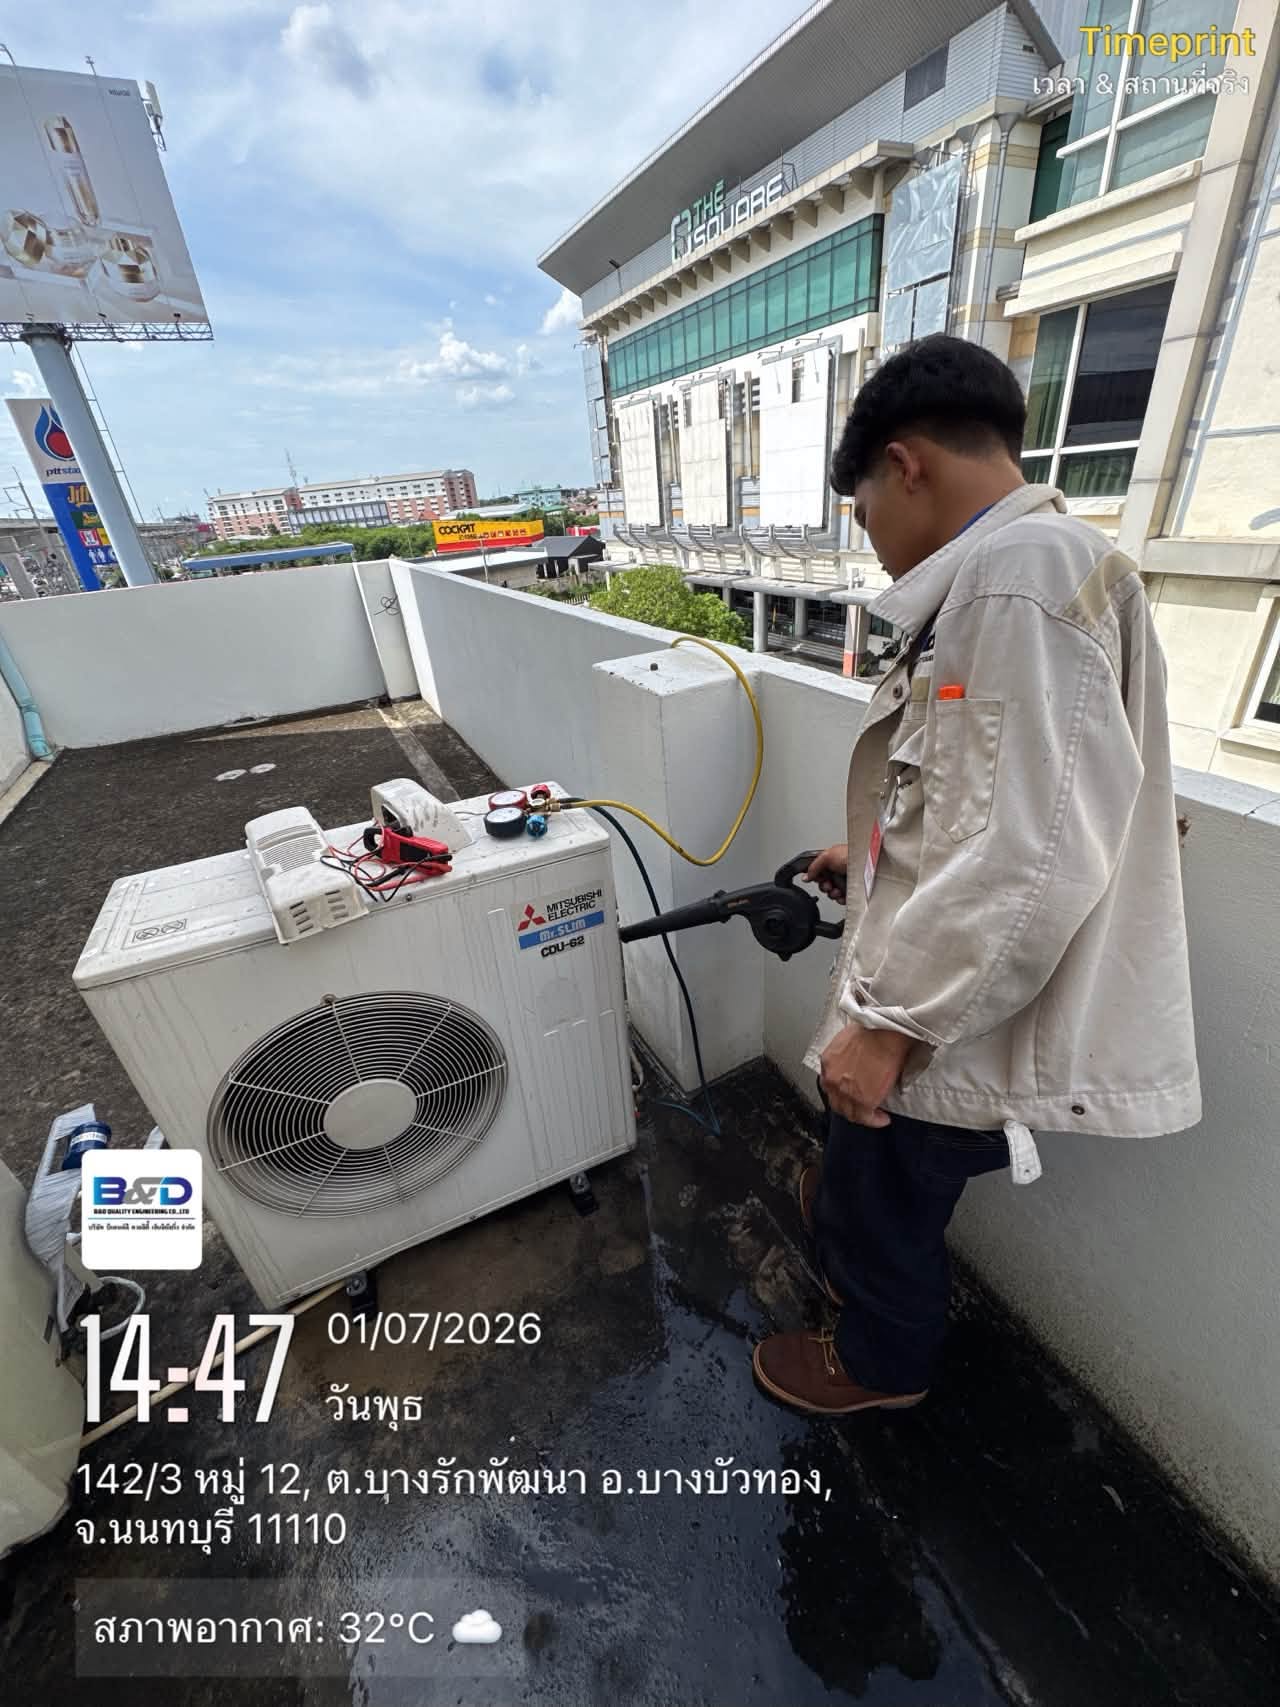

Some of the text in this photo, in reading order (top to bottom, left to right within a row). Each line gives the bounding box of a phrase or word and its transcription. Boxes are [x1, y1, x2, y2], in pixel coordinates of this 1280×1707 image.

[692, 179, 725, 225] THE
[693, 173, 783, 248] SQUARE
[438, 523, 476, 535] COCKPIT
[546, 888, 602, 913] MITSUBISHI
[548, 900, 596, 922] ELECTRIC
